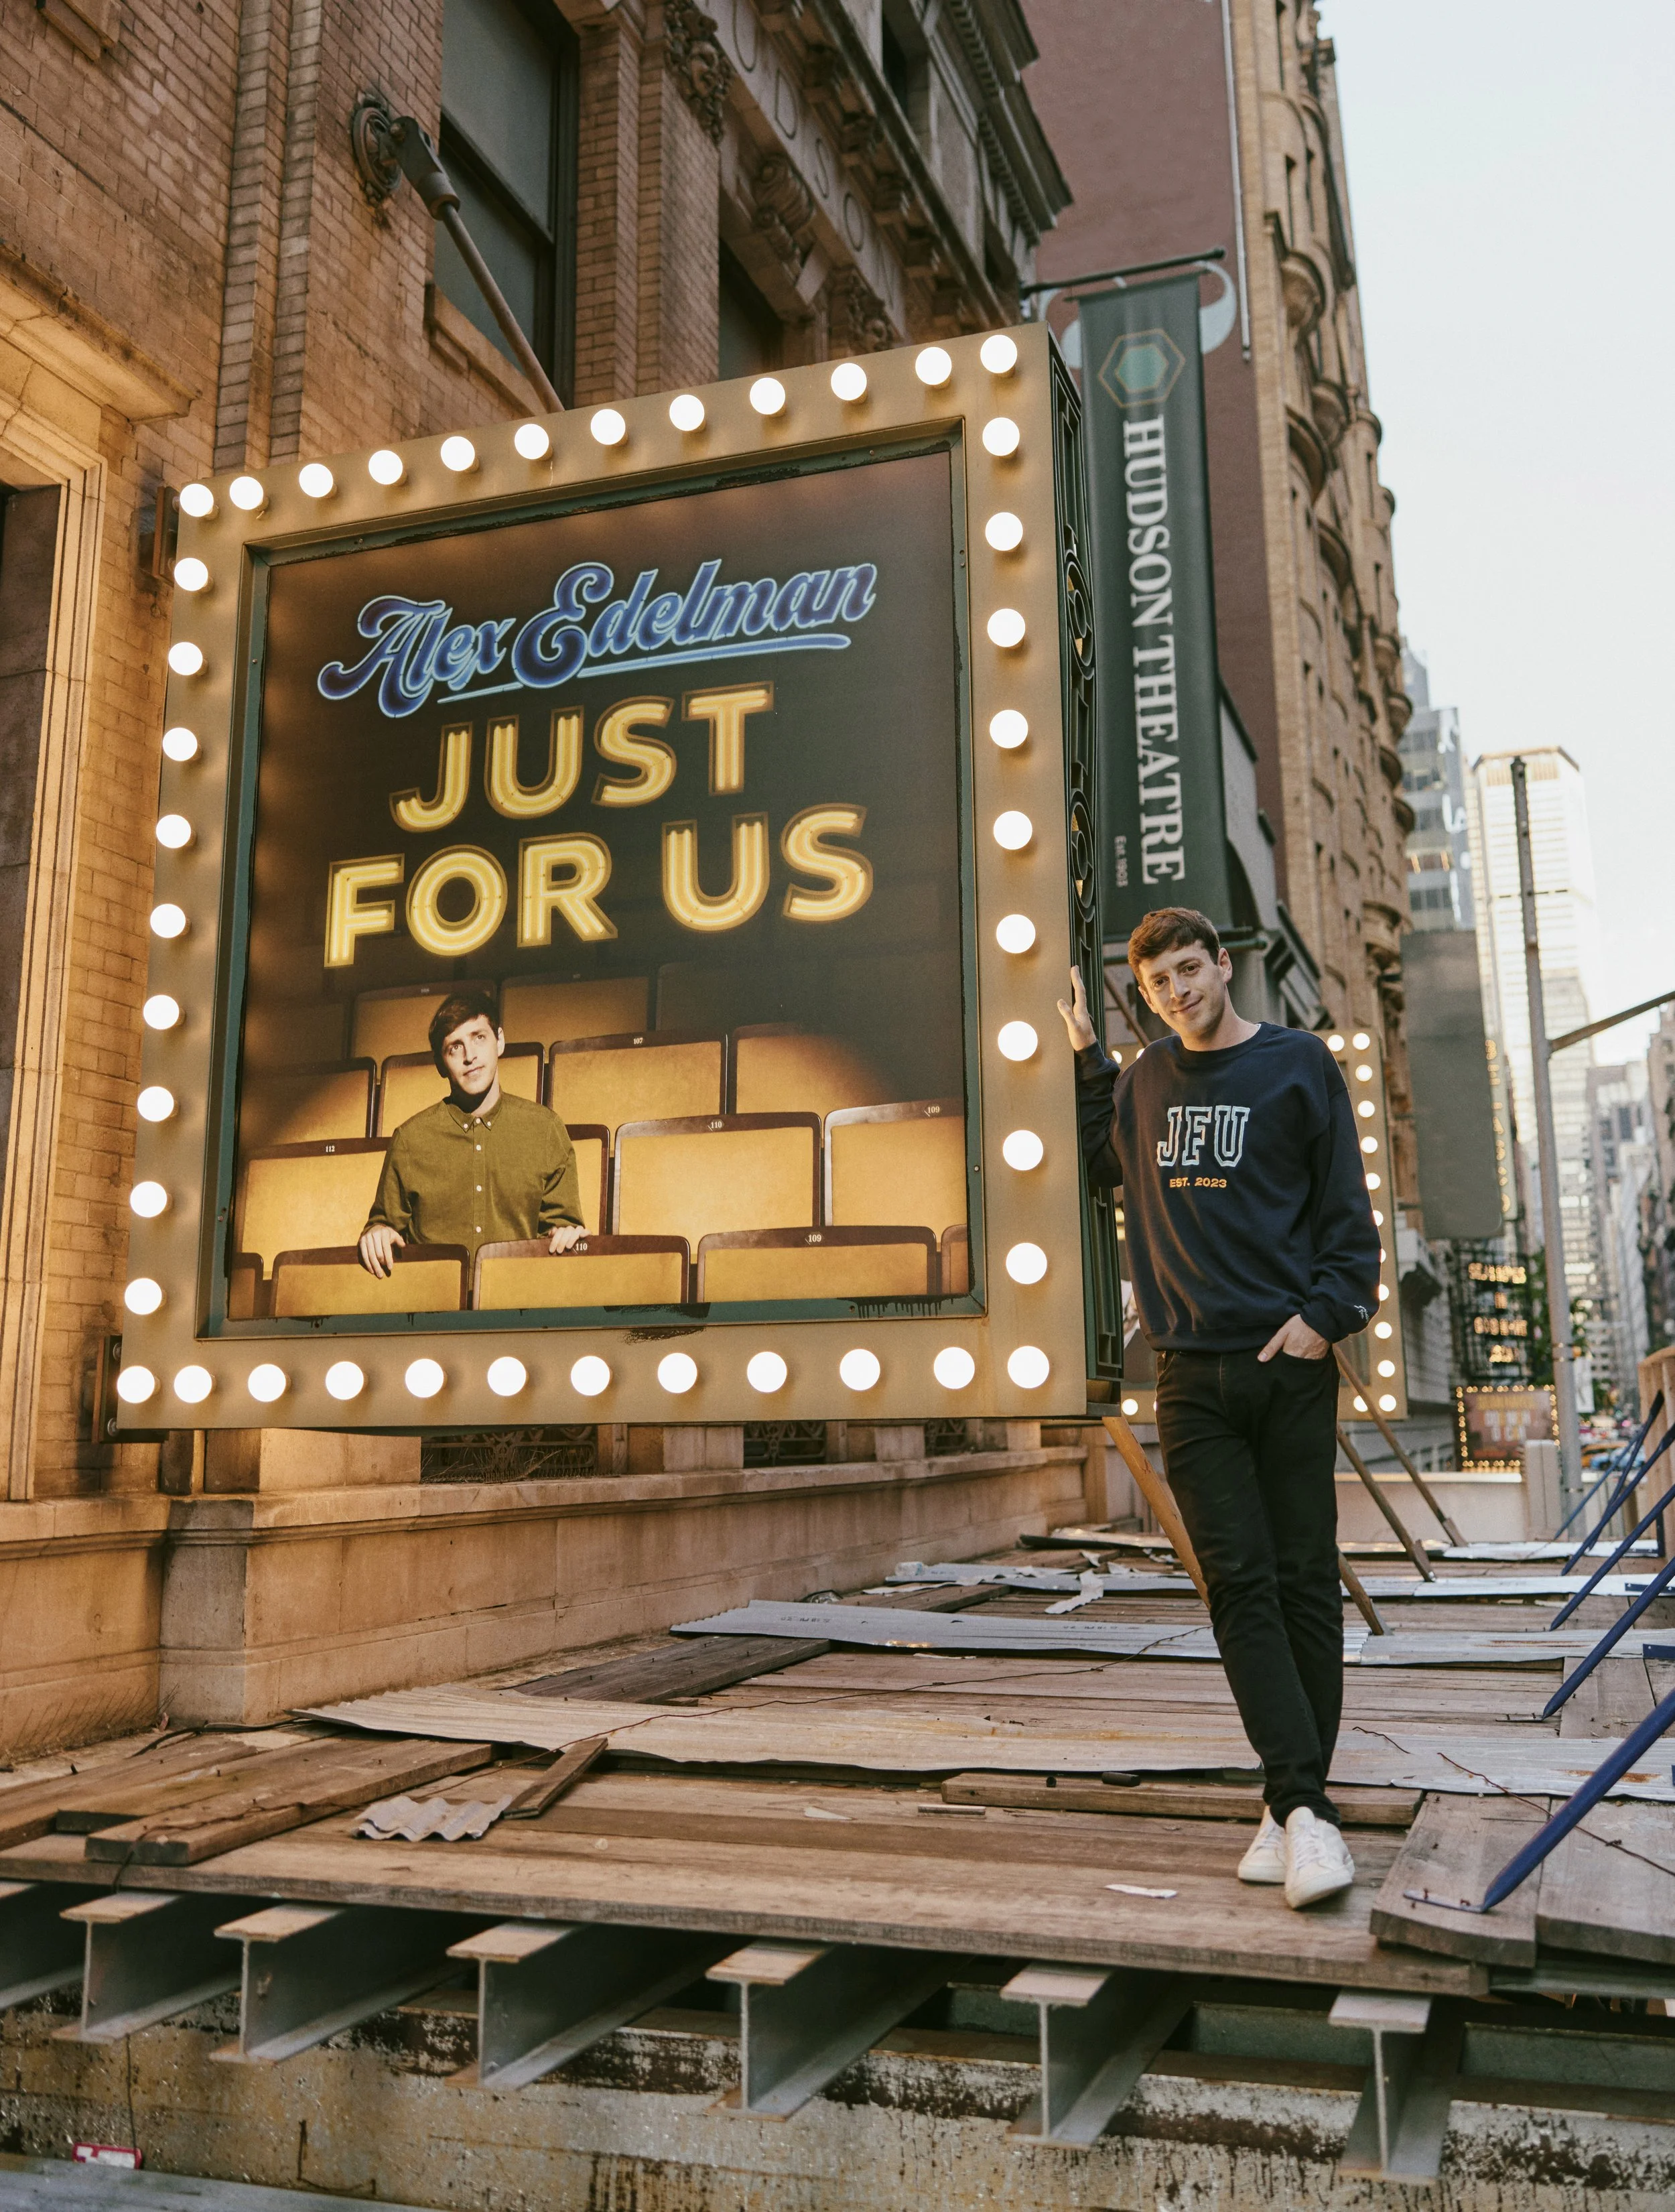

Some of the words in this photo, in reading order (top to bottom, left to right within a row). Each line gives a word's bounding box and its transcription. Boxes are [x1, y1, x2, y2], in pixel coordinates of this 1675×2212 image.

[1123, 415, 1174, 628] HUDSON
[318, 595, 515, 718] Alex
[512, 558, 878, 689] Edelman
[389, 681, 775, 833] JUST
[1133, 634, 1185, 885] THEATRE
[324, 832, 618, 968] FOR
[662, 803, 874, 932] US
[710, 1120, 723, 1129] 110
[927, 1106, 941, 1114] 109
[325, 1145, 335, 1153] 112
[1157, 1105, 1250, 1167] JFU
[1169, 1177, 1190, 1188] EST.
[1195, 1177, 1227, 1188] 2023
[574, 1242, 588, 1252] 110
[807, 1234, 823, 1244] 109
